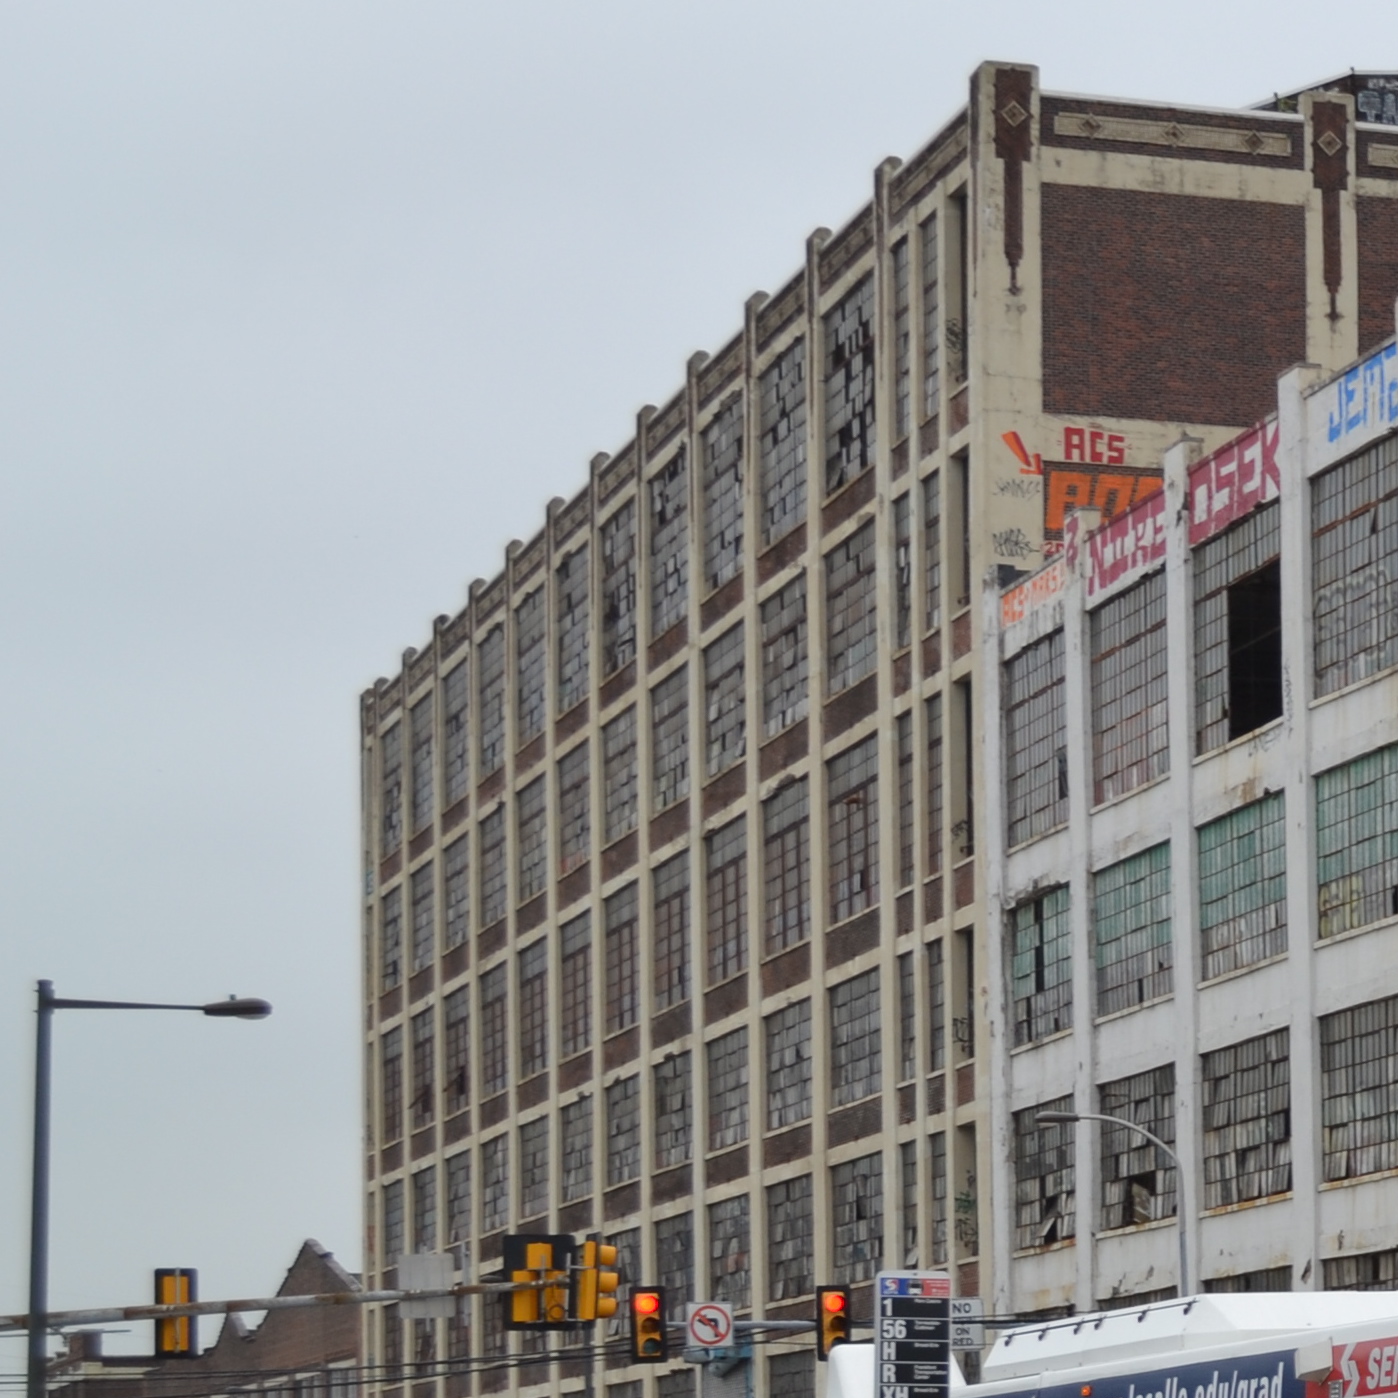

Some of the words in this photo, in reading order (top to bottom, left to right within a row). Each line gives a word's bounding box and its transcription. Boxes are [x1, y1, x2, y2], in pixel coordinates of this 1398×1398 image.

[883, 1298, 893, 1316] 1
[953, 1303, 972, 1314] NO
[882, 1320, 907, 1339] 56
[955, 1327, 971, 1336] ON
[883, 1342, 896, 1360] H
[882, 1364, 896, 1382] R
